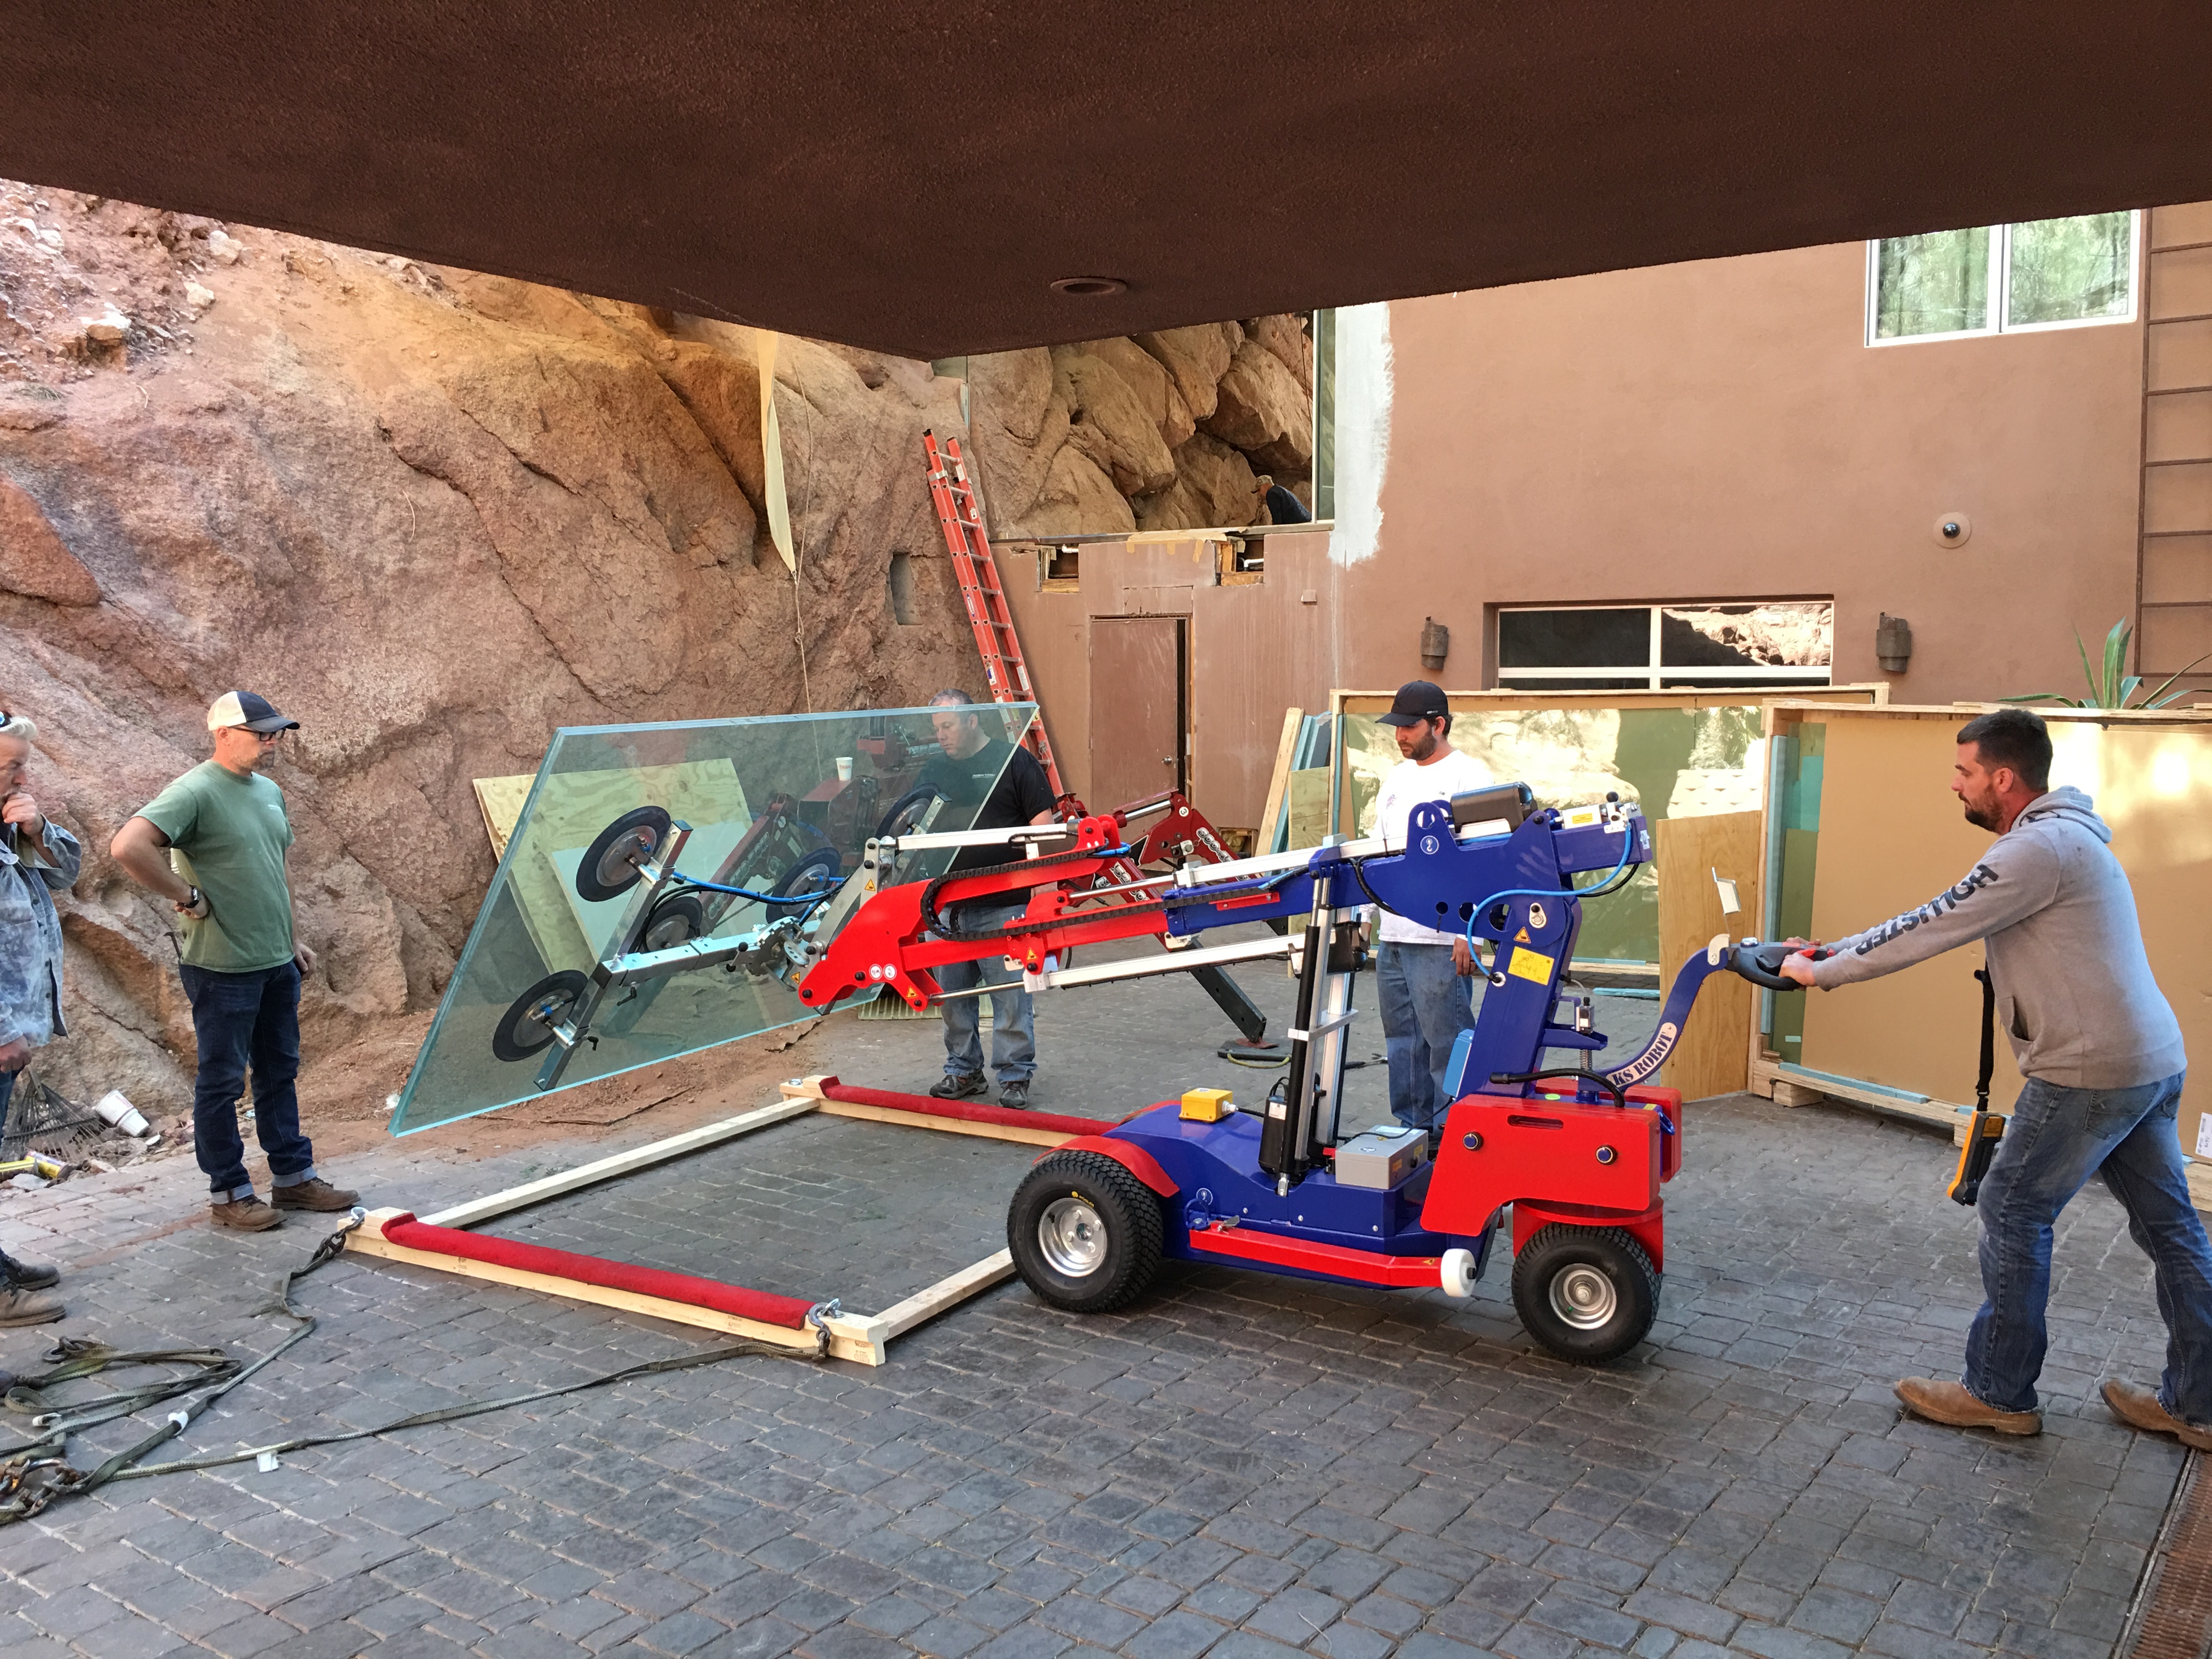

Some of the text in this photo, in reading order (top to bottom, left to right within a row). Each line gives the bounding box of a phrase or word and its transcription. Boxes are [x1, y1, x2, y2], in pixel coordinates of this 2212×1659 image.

[1855, 864, 1999, 956] HOLLISTER
[1612, 1031, 1672, 1086] KS ROBOT
